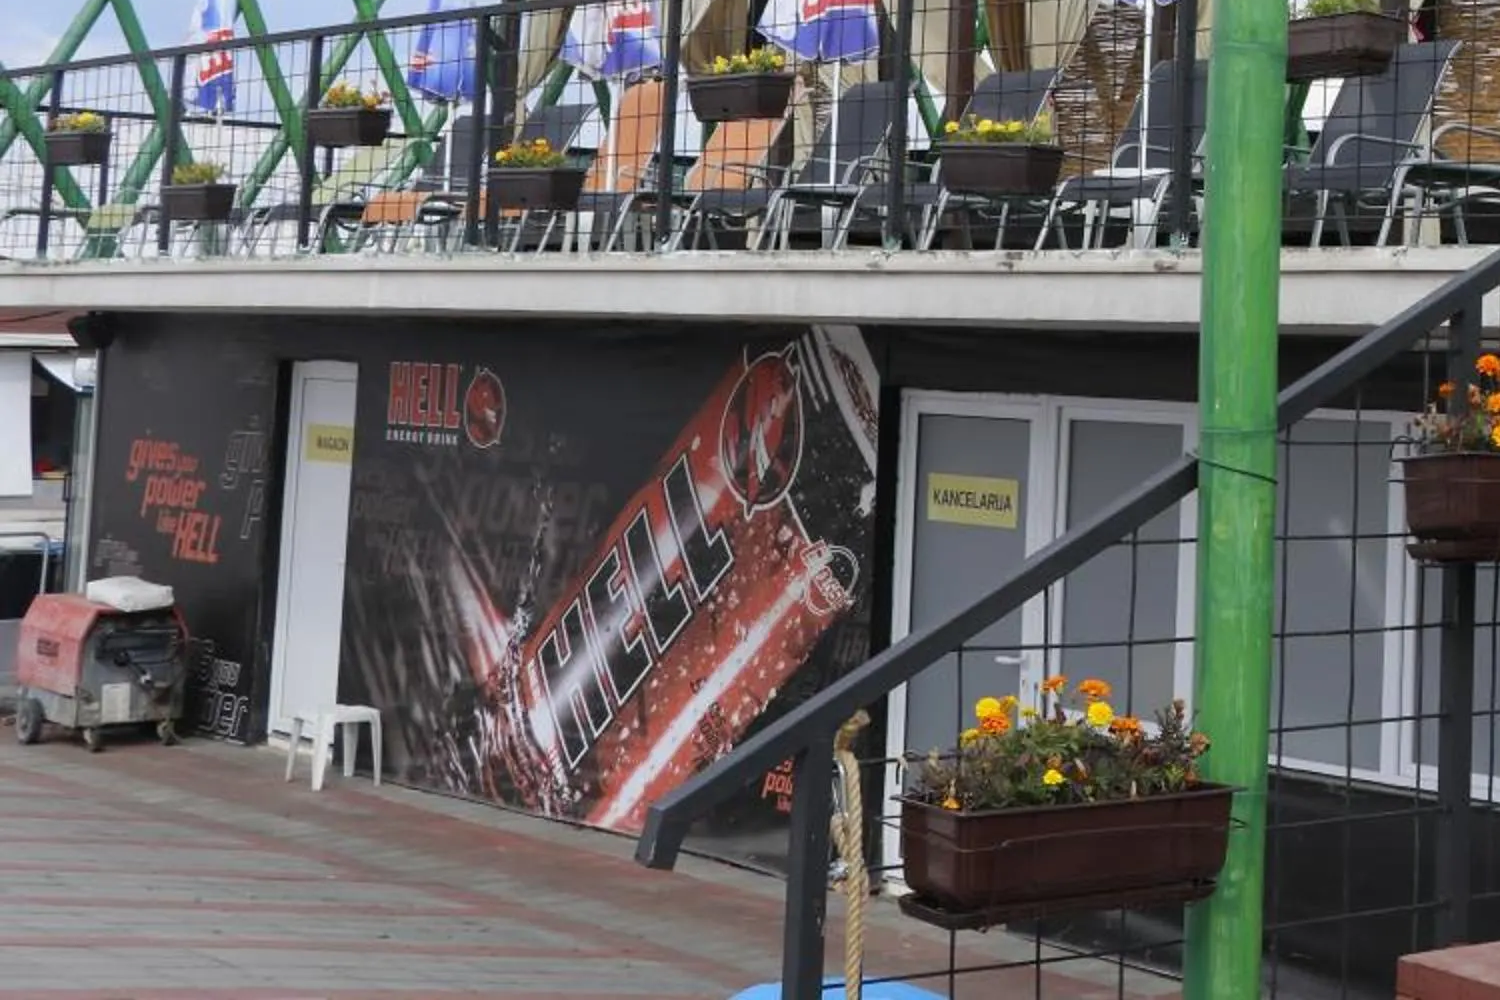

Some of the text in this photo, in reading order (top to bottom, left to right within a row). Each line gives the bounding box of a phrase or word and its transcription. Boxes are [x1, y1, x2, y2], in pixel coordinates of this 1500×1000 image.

[387, 361, 461, 429] HELL
[126, 438, 180, 482] gives
[140, 474, 207, 519] power
[171, 509, 223, 564] HELL
[537, 452, 735, 771] HELL
